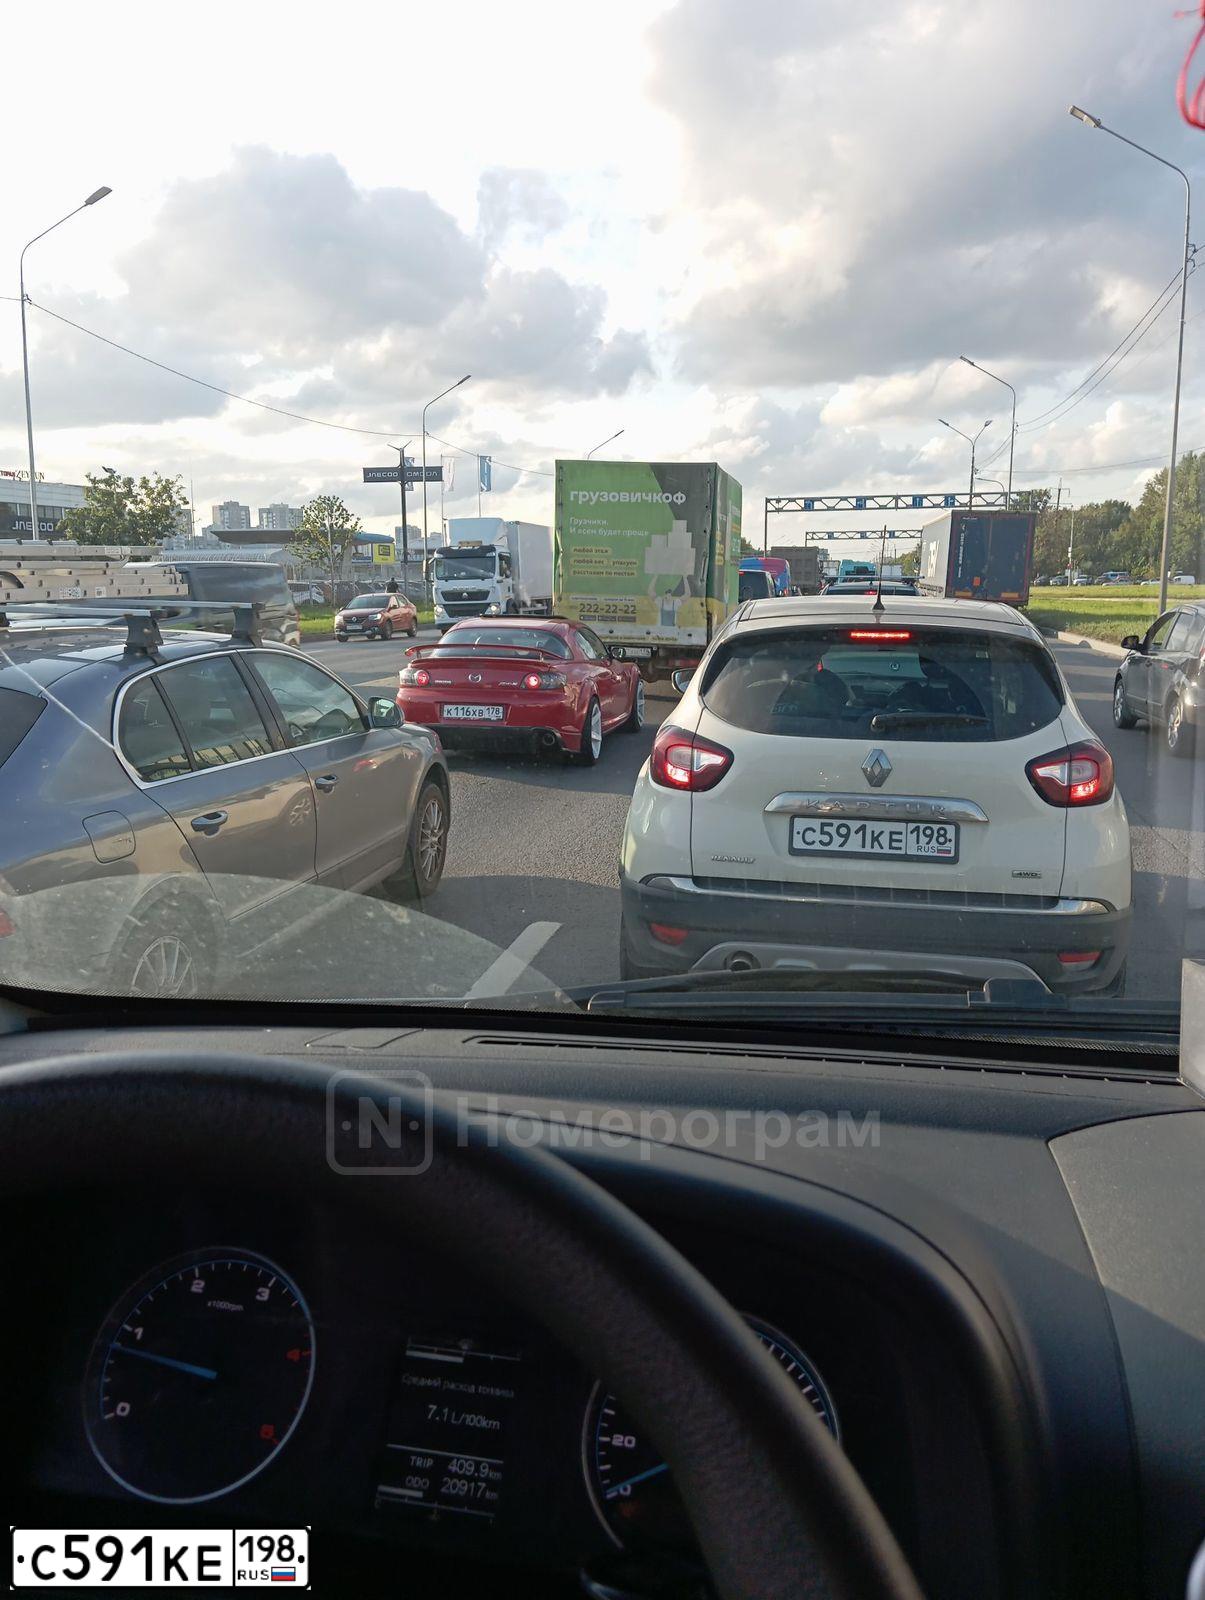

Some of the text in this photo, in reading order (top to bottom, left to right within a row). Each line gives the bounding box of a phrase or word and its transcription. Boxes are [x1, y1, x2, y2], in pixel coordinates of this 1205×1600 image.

[16, 470, 45, 480] ZEYUN
[570, 490, 687, 505] грузовичкоф
[12, 520, 54, 532] JAEOO
[579, 603, 637, 614] 222-22-22
[485, 706, 501, 716] 178
[806, 799, 947, 819] KAPTUR
[909, 824, 949, 846] 198
[916, 845, 937, 854] RUS
[190, 1279, 206, 1294] 2
[255, 1287, 271, 1301] 3
[133, 1326, 144, 1341] 1
[115, 1401, 132, 1417] 0
[427, 1404, 449, 1421] 7.1
[612, 1434, 636, 1449] 20
[409, 1455, 434, 1468] TRIP
[447, 1458, 489, 1478] 409.9
[404, 1475, 430, 1490] ODO
[440, 1476, 487, 1500] 20917
